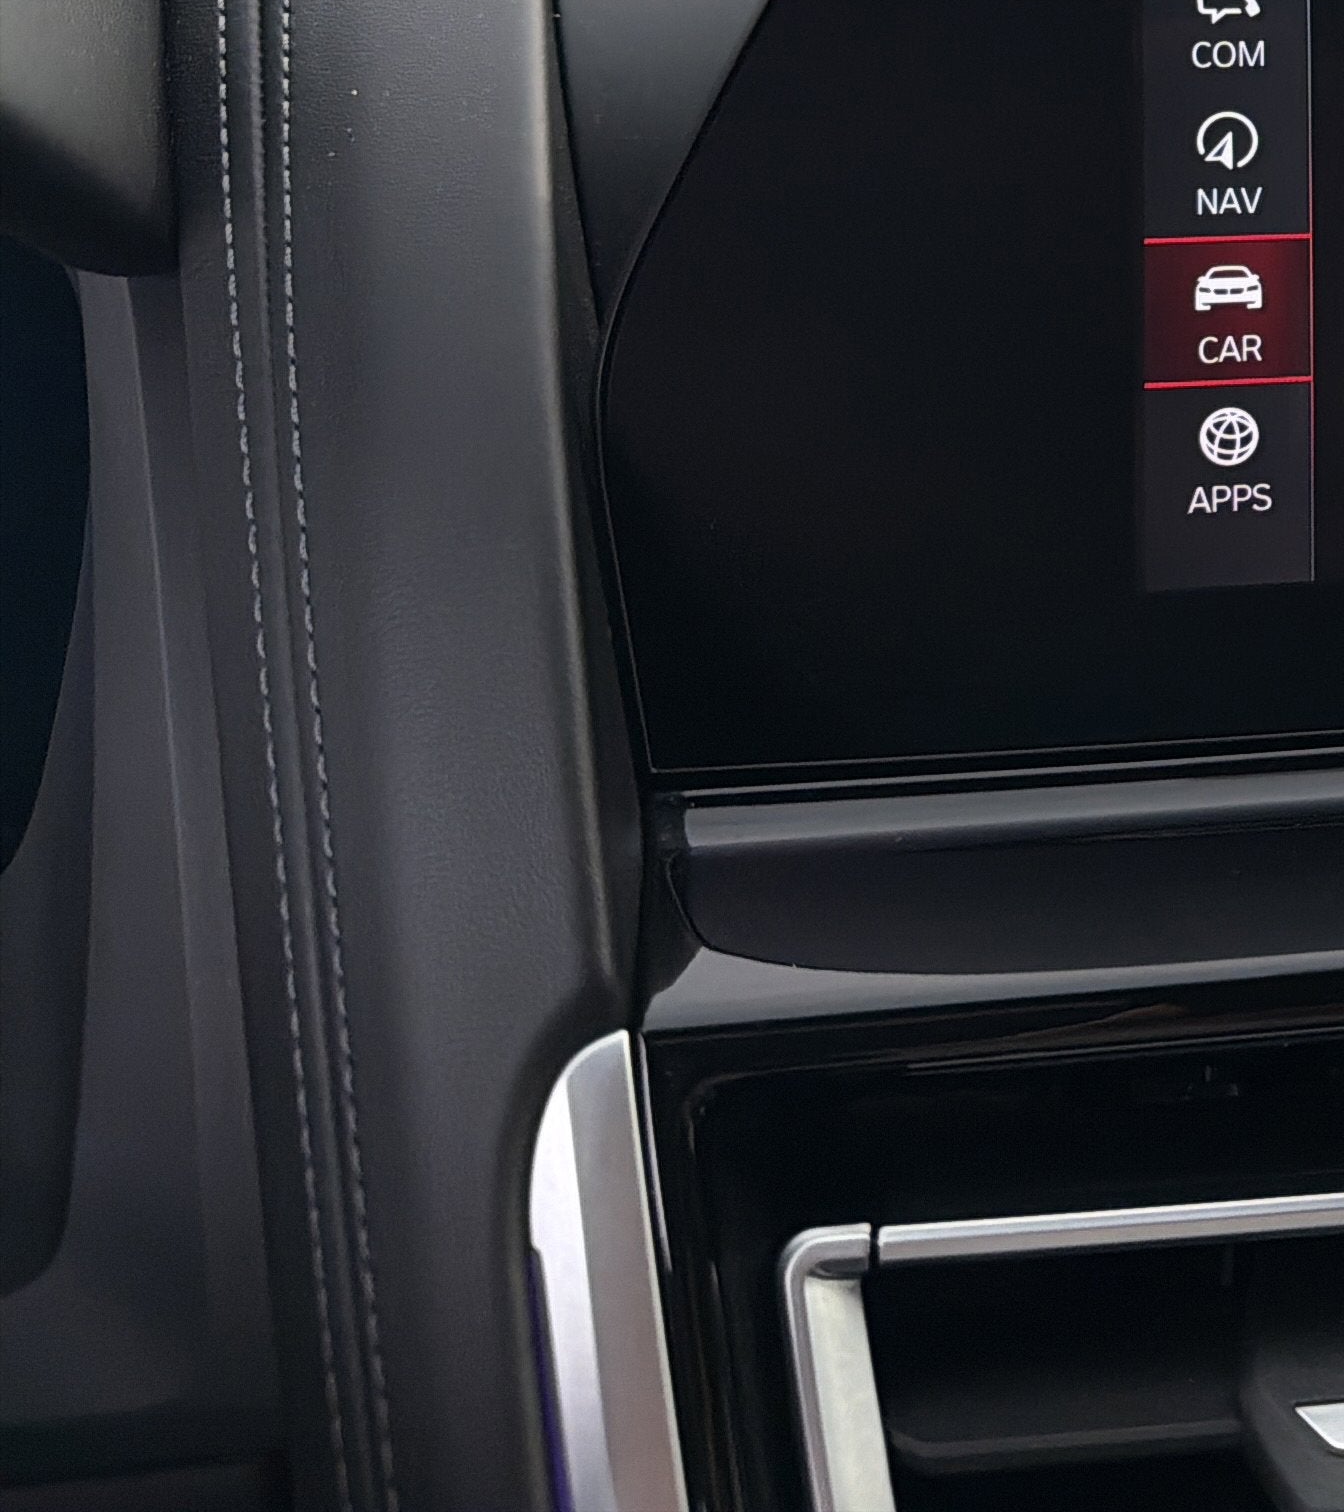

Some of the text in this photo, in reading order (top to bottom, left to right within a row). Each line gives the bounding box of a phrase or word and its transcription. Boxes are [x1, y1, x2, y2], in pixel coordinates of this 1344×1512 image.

[1191, 40, 1265, 68] COM
[1196, 187, 1263, 215] NAV
[1198, 335, 1263, 364] CAR
[1187, 484, 1272, 514] APPS
